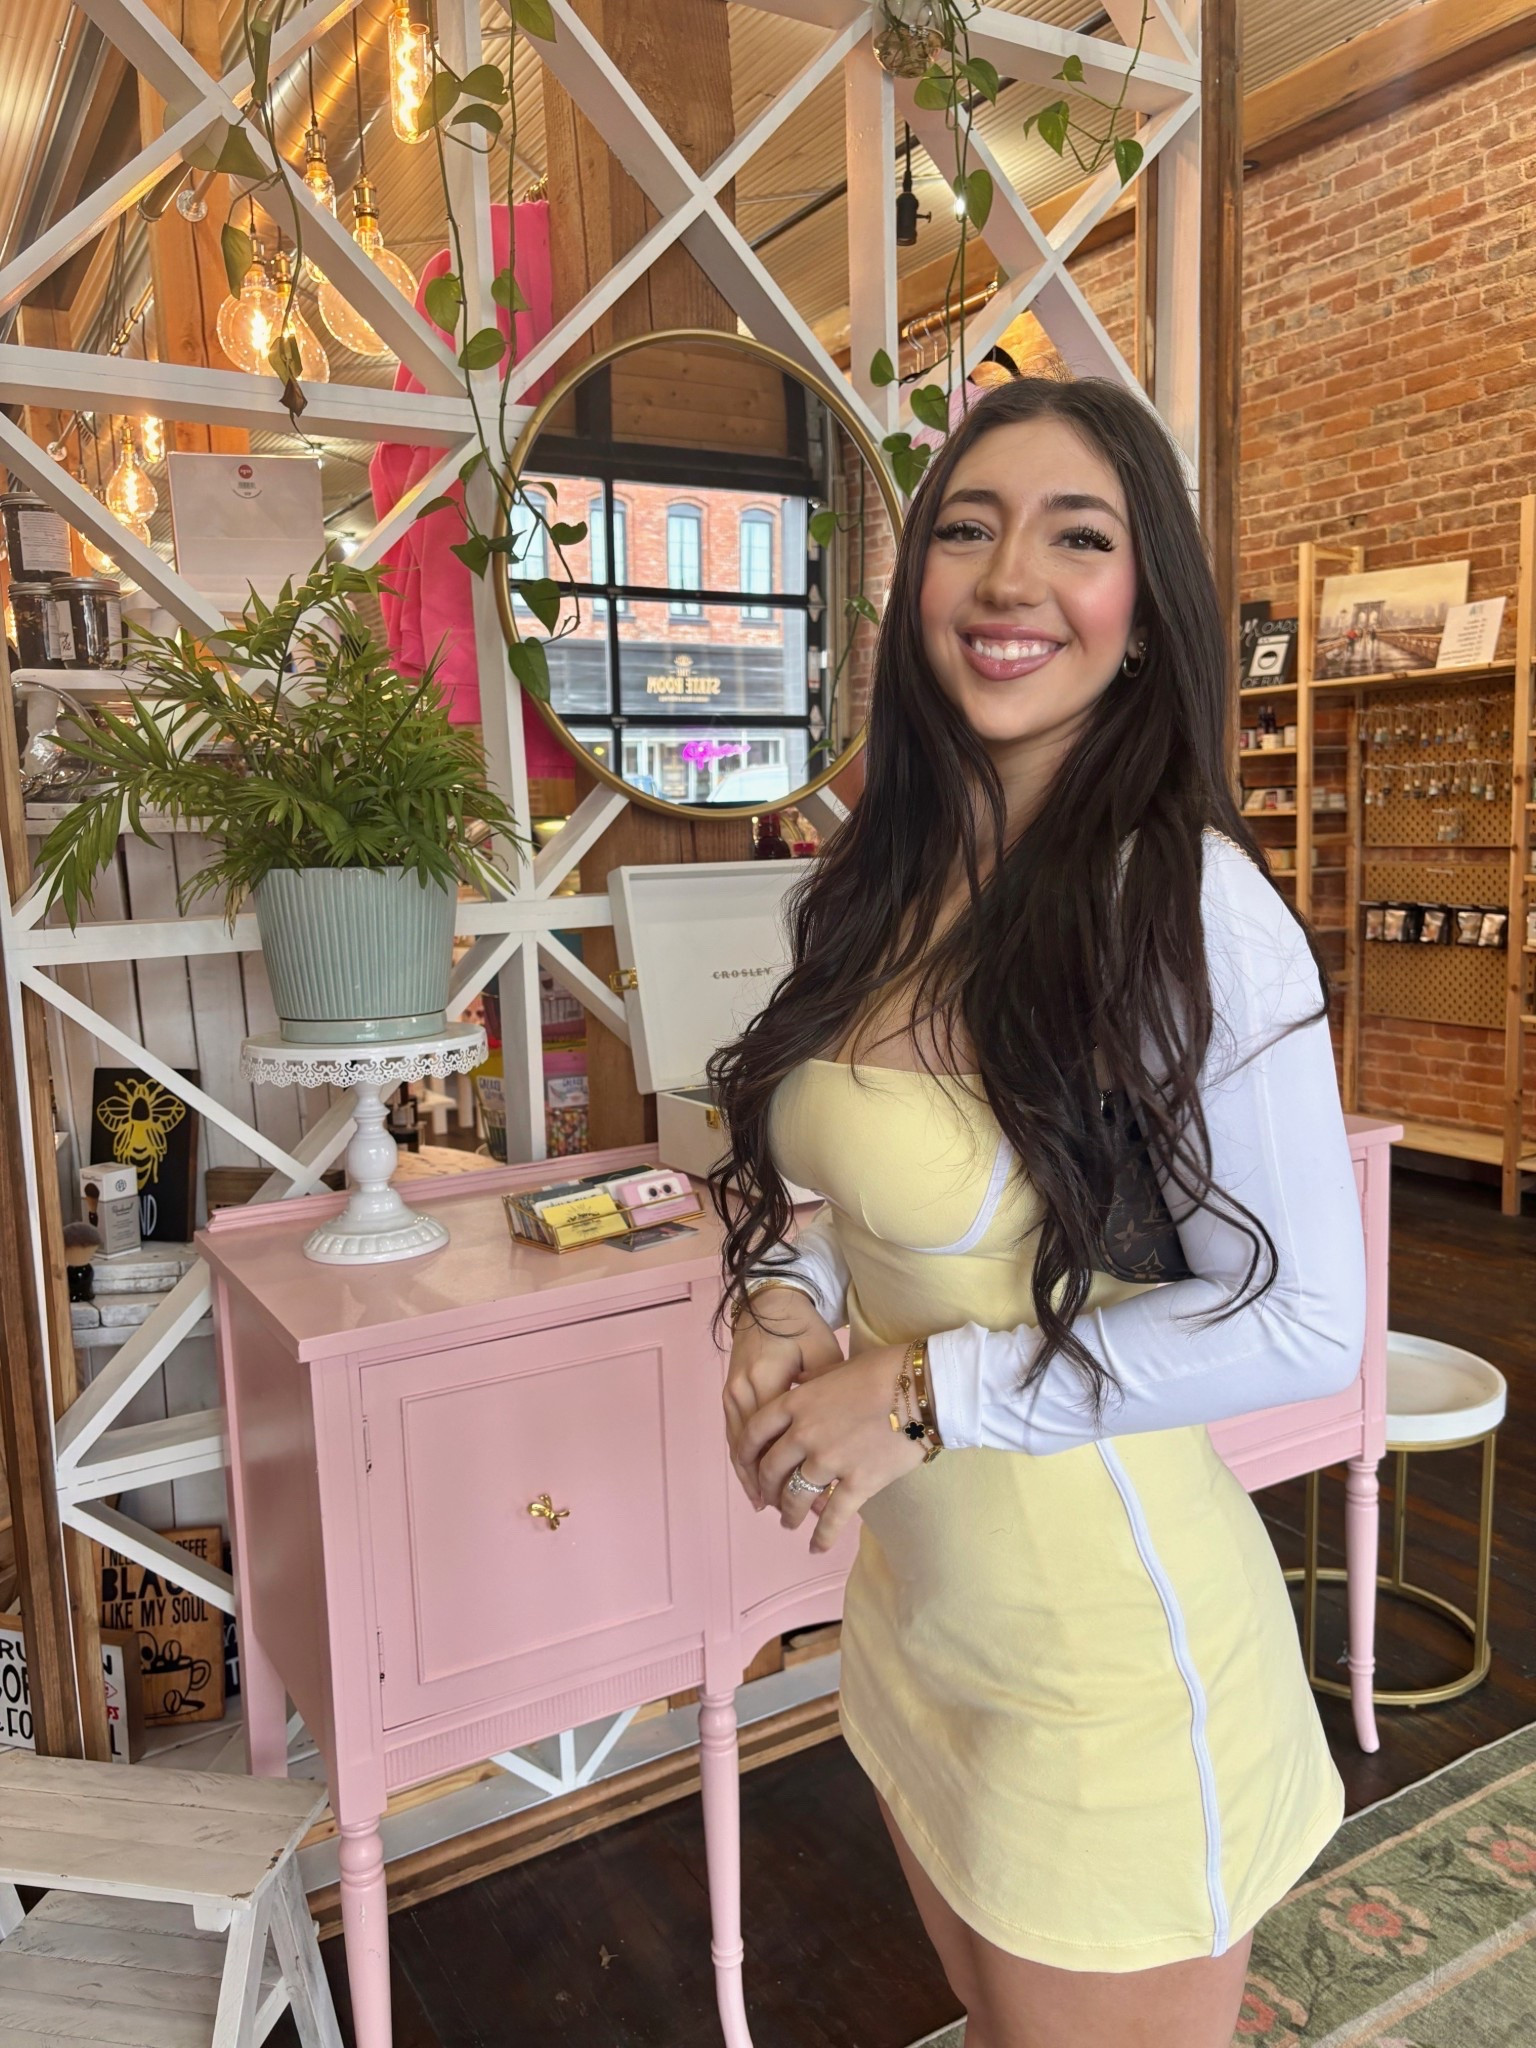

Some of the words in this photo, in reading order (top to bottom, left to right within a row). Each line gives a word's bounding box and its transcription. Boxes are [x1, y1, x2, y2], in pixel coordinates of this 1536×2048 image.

[712, 967, 771, 980] CROSLEY
[102, 1567, 195, 1602] BLAC
[101, 1602, 133, 1630] LIKE
[141, 1598, 166, 1628] MY
[172, 1596, 209, 1625] SOUL
